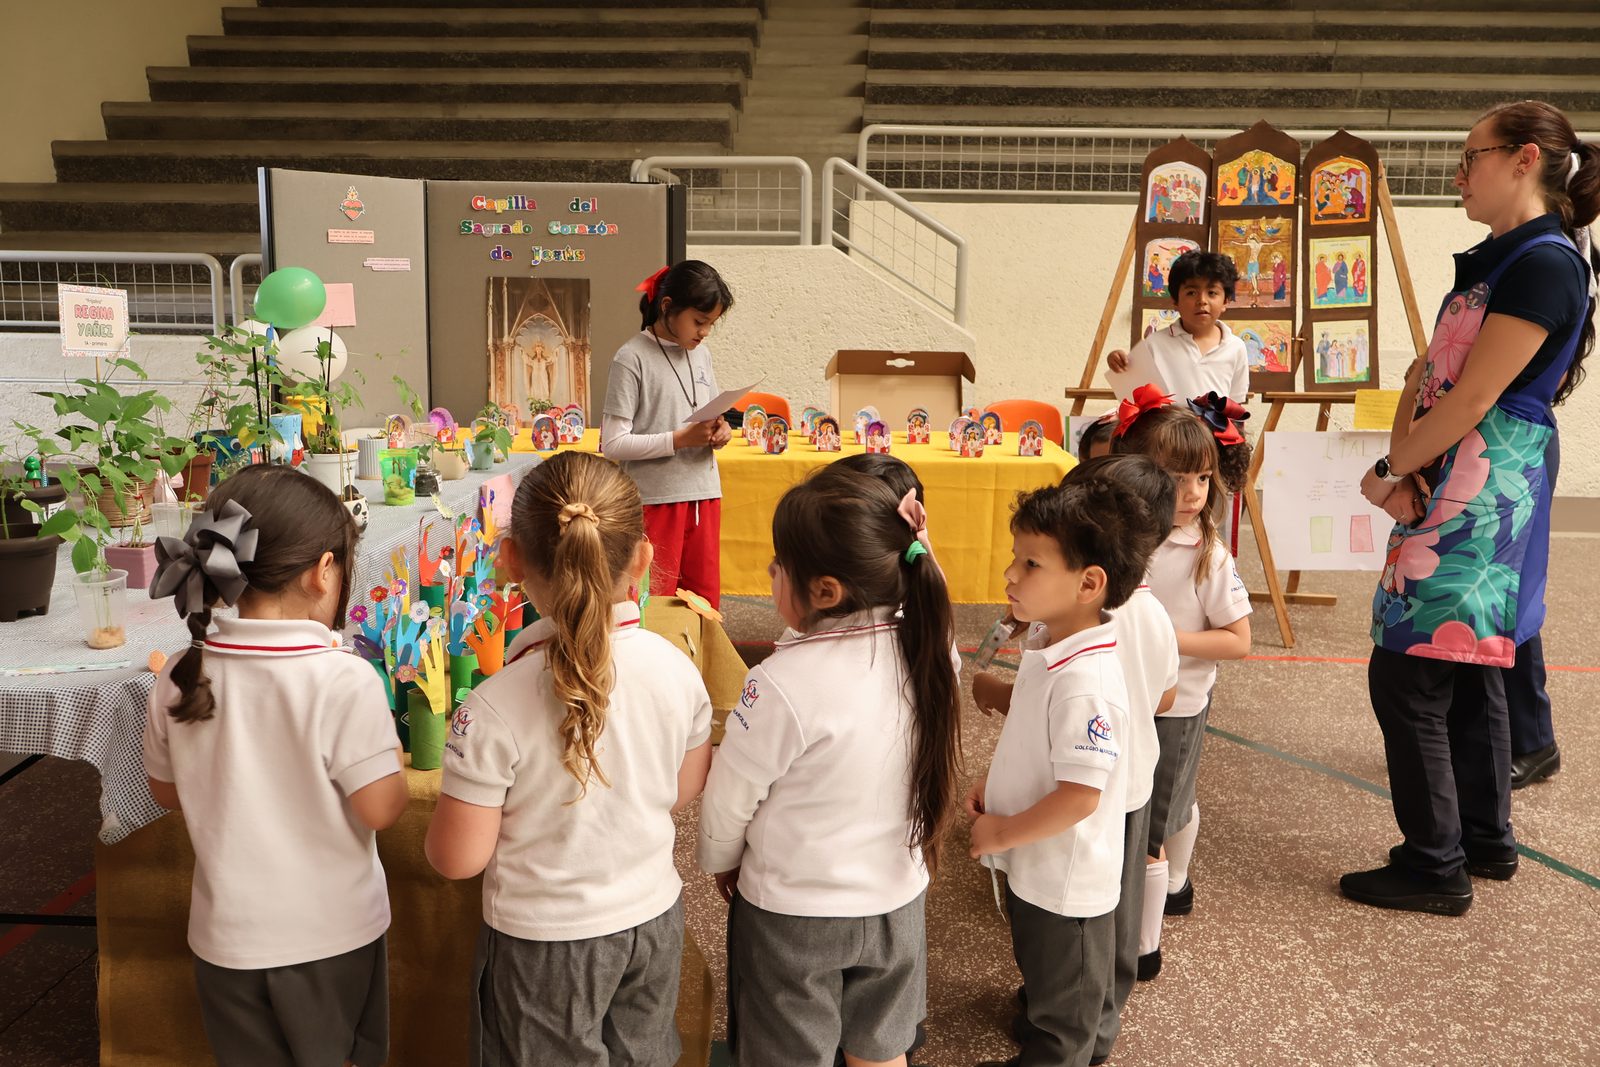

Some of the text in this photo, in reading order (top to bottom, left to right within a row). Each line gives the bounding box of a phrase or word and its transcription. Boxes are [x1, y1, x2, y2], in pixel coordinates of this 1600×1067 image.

[471, 195, 598, 213] Capilla del
[461, 219, 618, 237] Sagrado Corazón
[490, 244, 586, 265] de Jesús
[74, 304, 114, 320] REGINA
[77, 321, 113, 338] YAÑEZ
